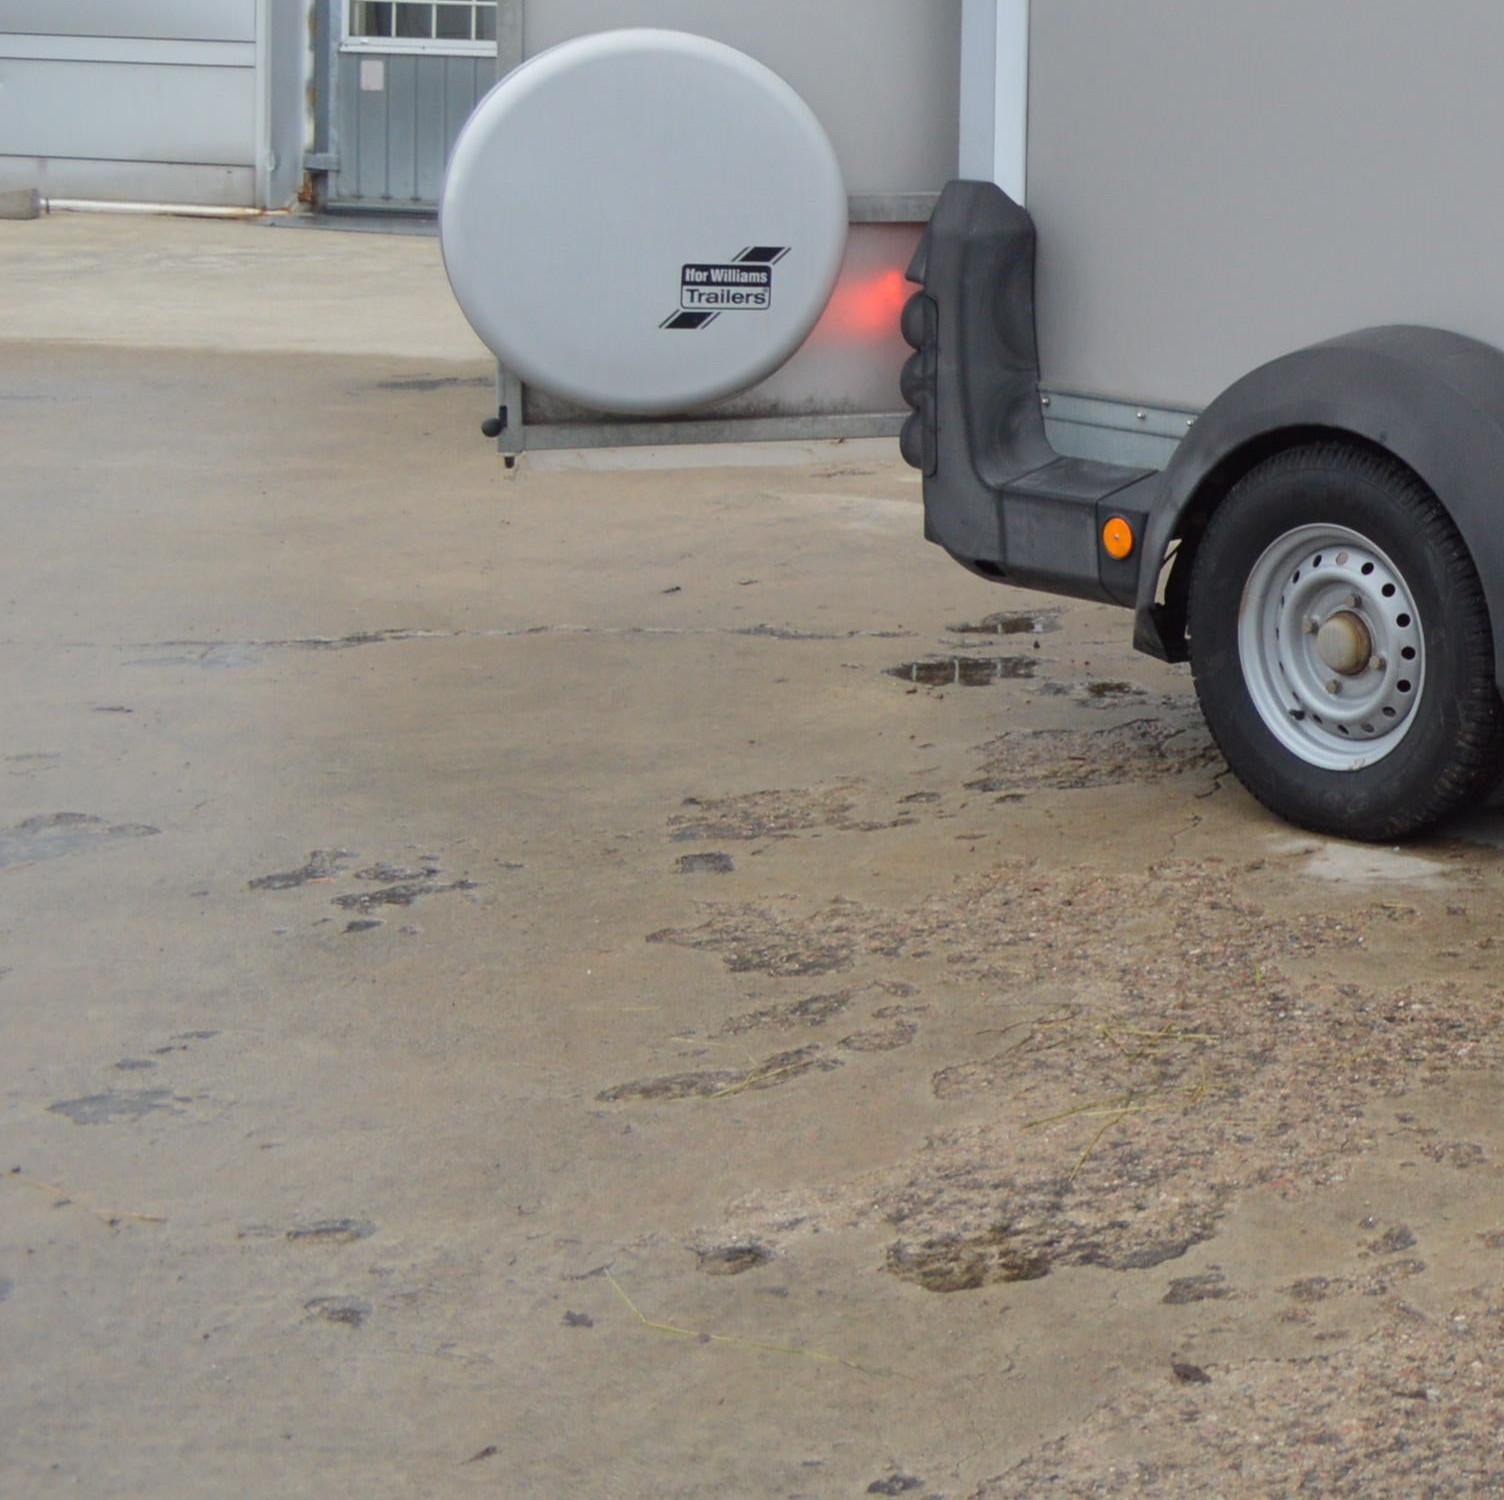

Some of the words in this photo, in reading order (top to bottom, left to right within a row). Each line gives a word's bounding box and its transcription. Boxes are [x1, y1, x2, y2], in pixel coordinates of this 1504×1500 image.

[685, 267, 708, 283] Ifor
[710, 268, 768, 284] Williams
[686, 288, 767, 305] Trailers
